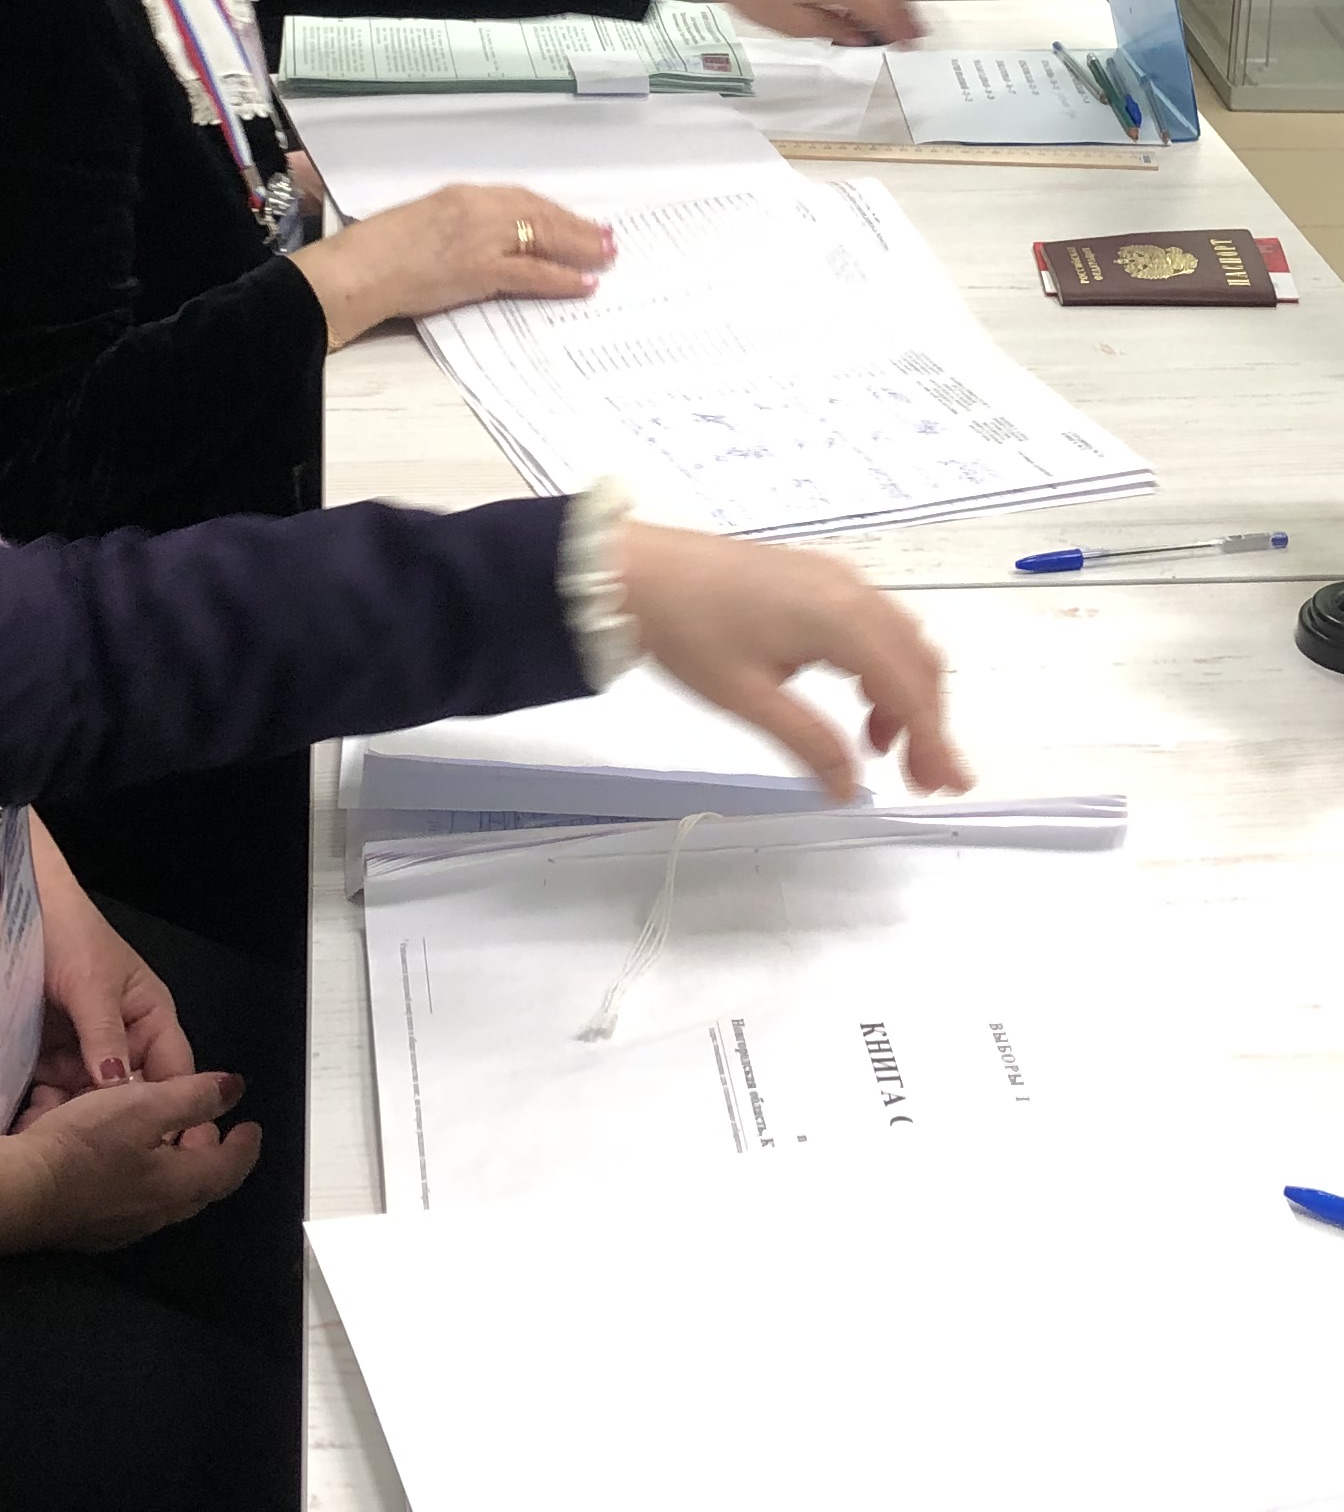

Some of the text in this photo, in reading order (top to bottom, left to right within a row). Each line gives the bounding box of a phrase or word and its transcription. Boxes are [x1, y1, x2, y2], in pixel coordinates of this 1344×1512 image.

[1209, 238, 1251, 287] ПАСПОРТ
[859, 1021, 907, 1108] КНИГА
[988, 1022, 1025, 1086] ВЫБОРЫ
